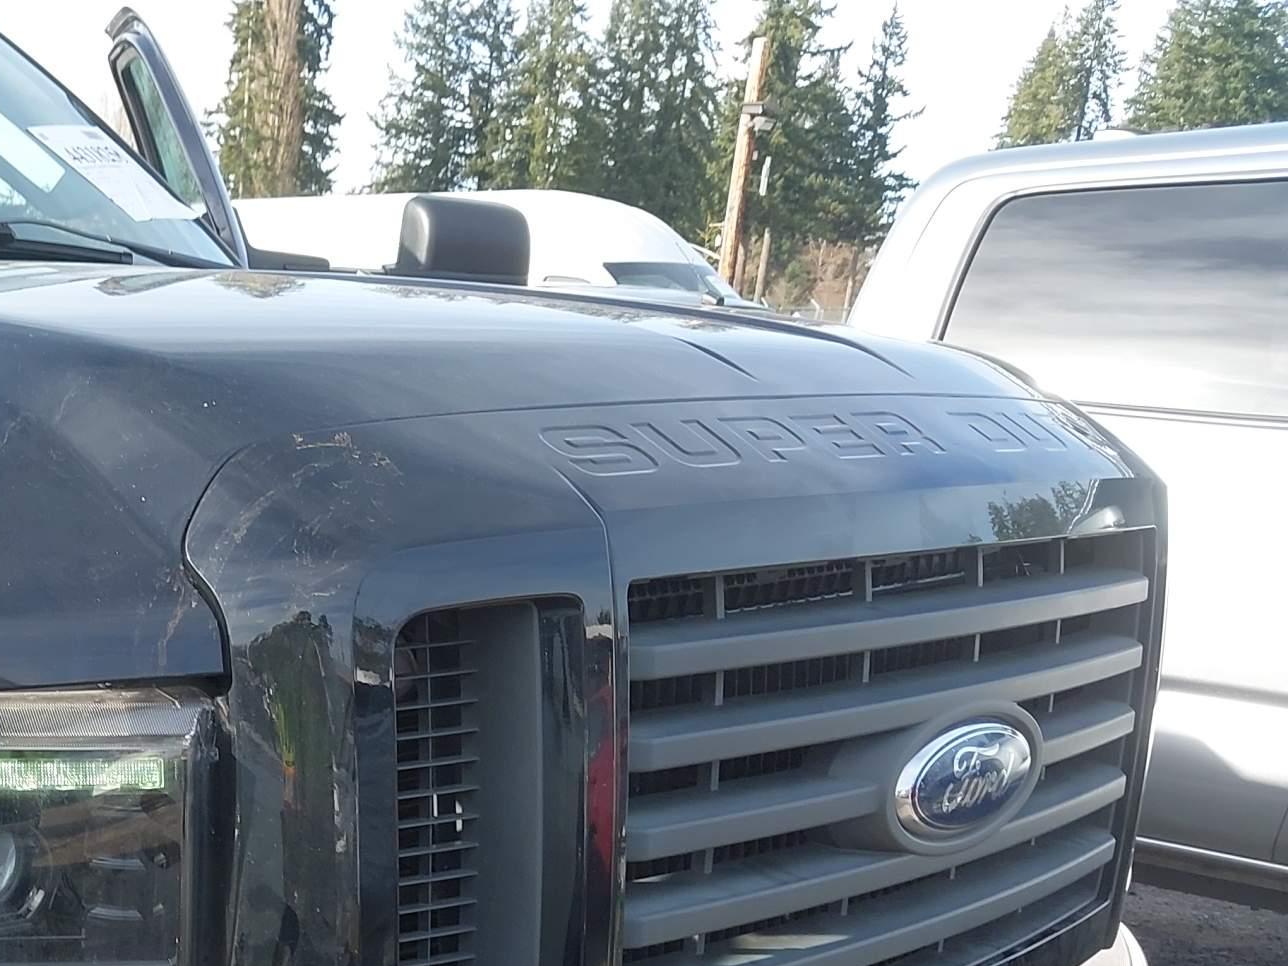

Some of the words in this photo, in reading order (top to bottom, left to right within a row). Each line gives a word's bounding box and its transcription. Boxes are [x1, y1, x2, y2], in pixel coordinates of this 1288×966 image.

[539, 411, 947, 476] SUPER
[946, 409, 1069, 452] DU
[936, 743, 1015, 813] Ford
